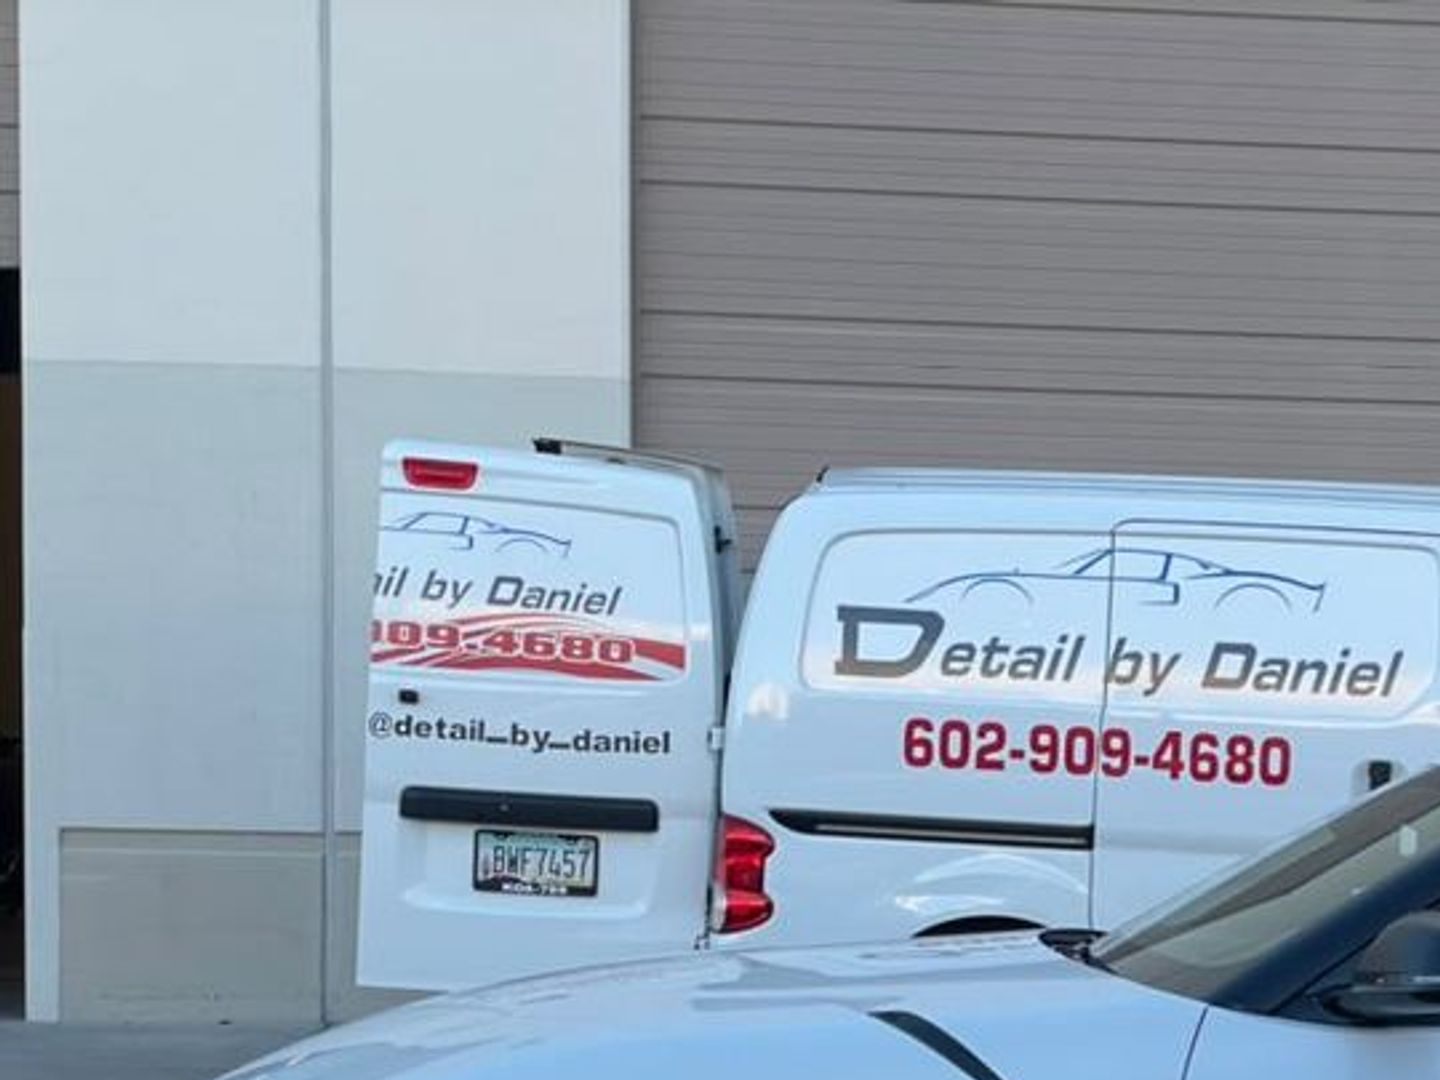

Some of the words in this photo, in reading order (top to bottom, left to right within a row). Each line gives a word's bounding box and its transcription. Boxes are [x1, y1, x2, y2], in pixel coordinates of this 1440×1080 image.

[421, 569, 473, 609] by
[486, 575, 623, 617] Daniel
[834, 603, 1086, 684] Detail
[1104, 637, 1182, 698] by
[1201, 641, 1404, 698] Daniel
[369, 711, 671, 754] @detail_by_daniel
[903, 717, 1291, 787] 602-909-4680
